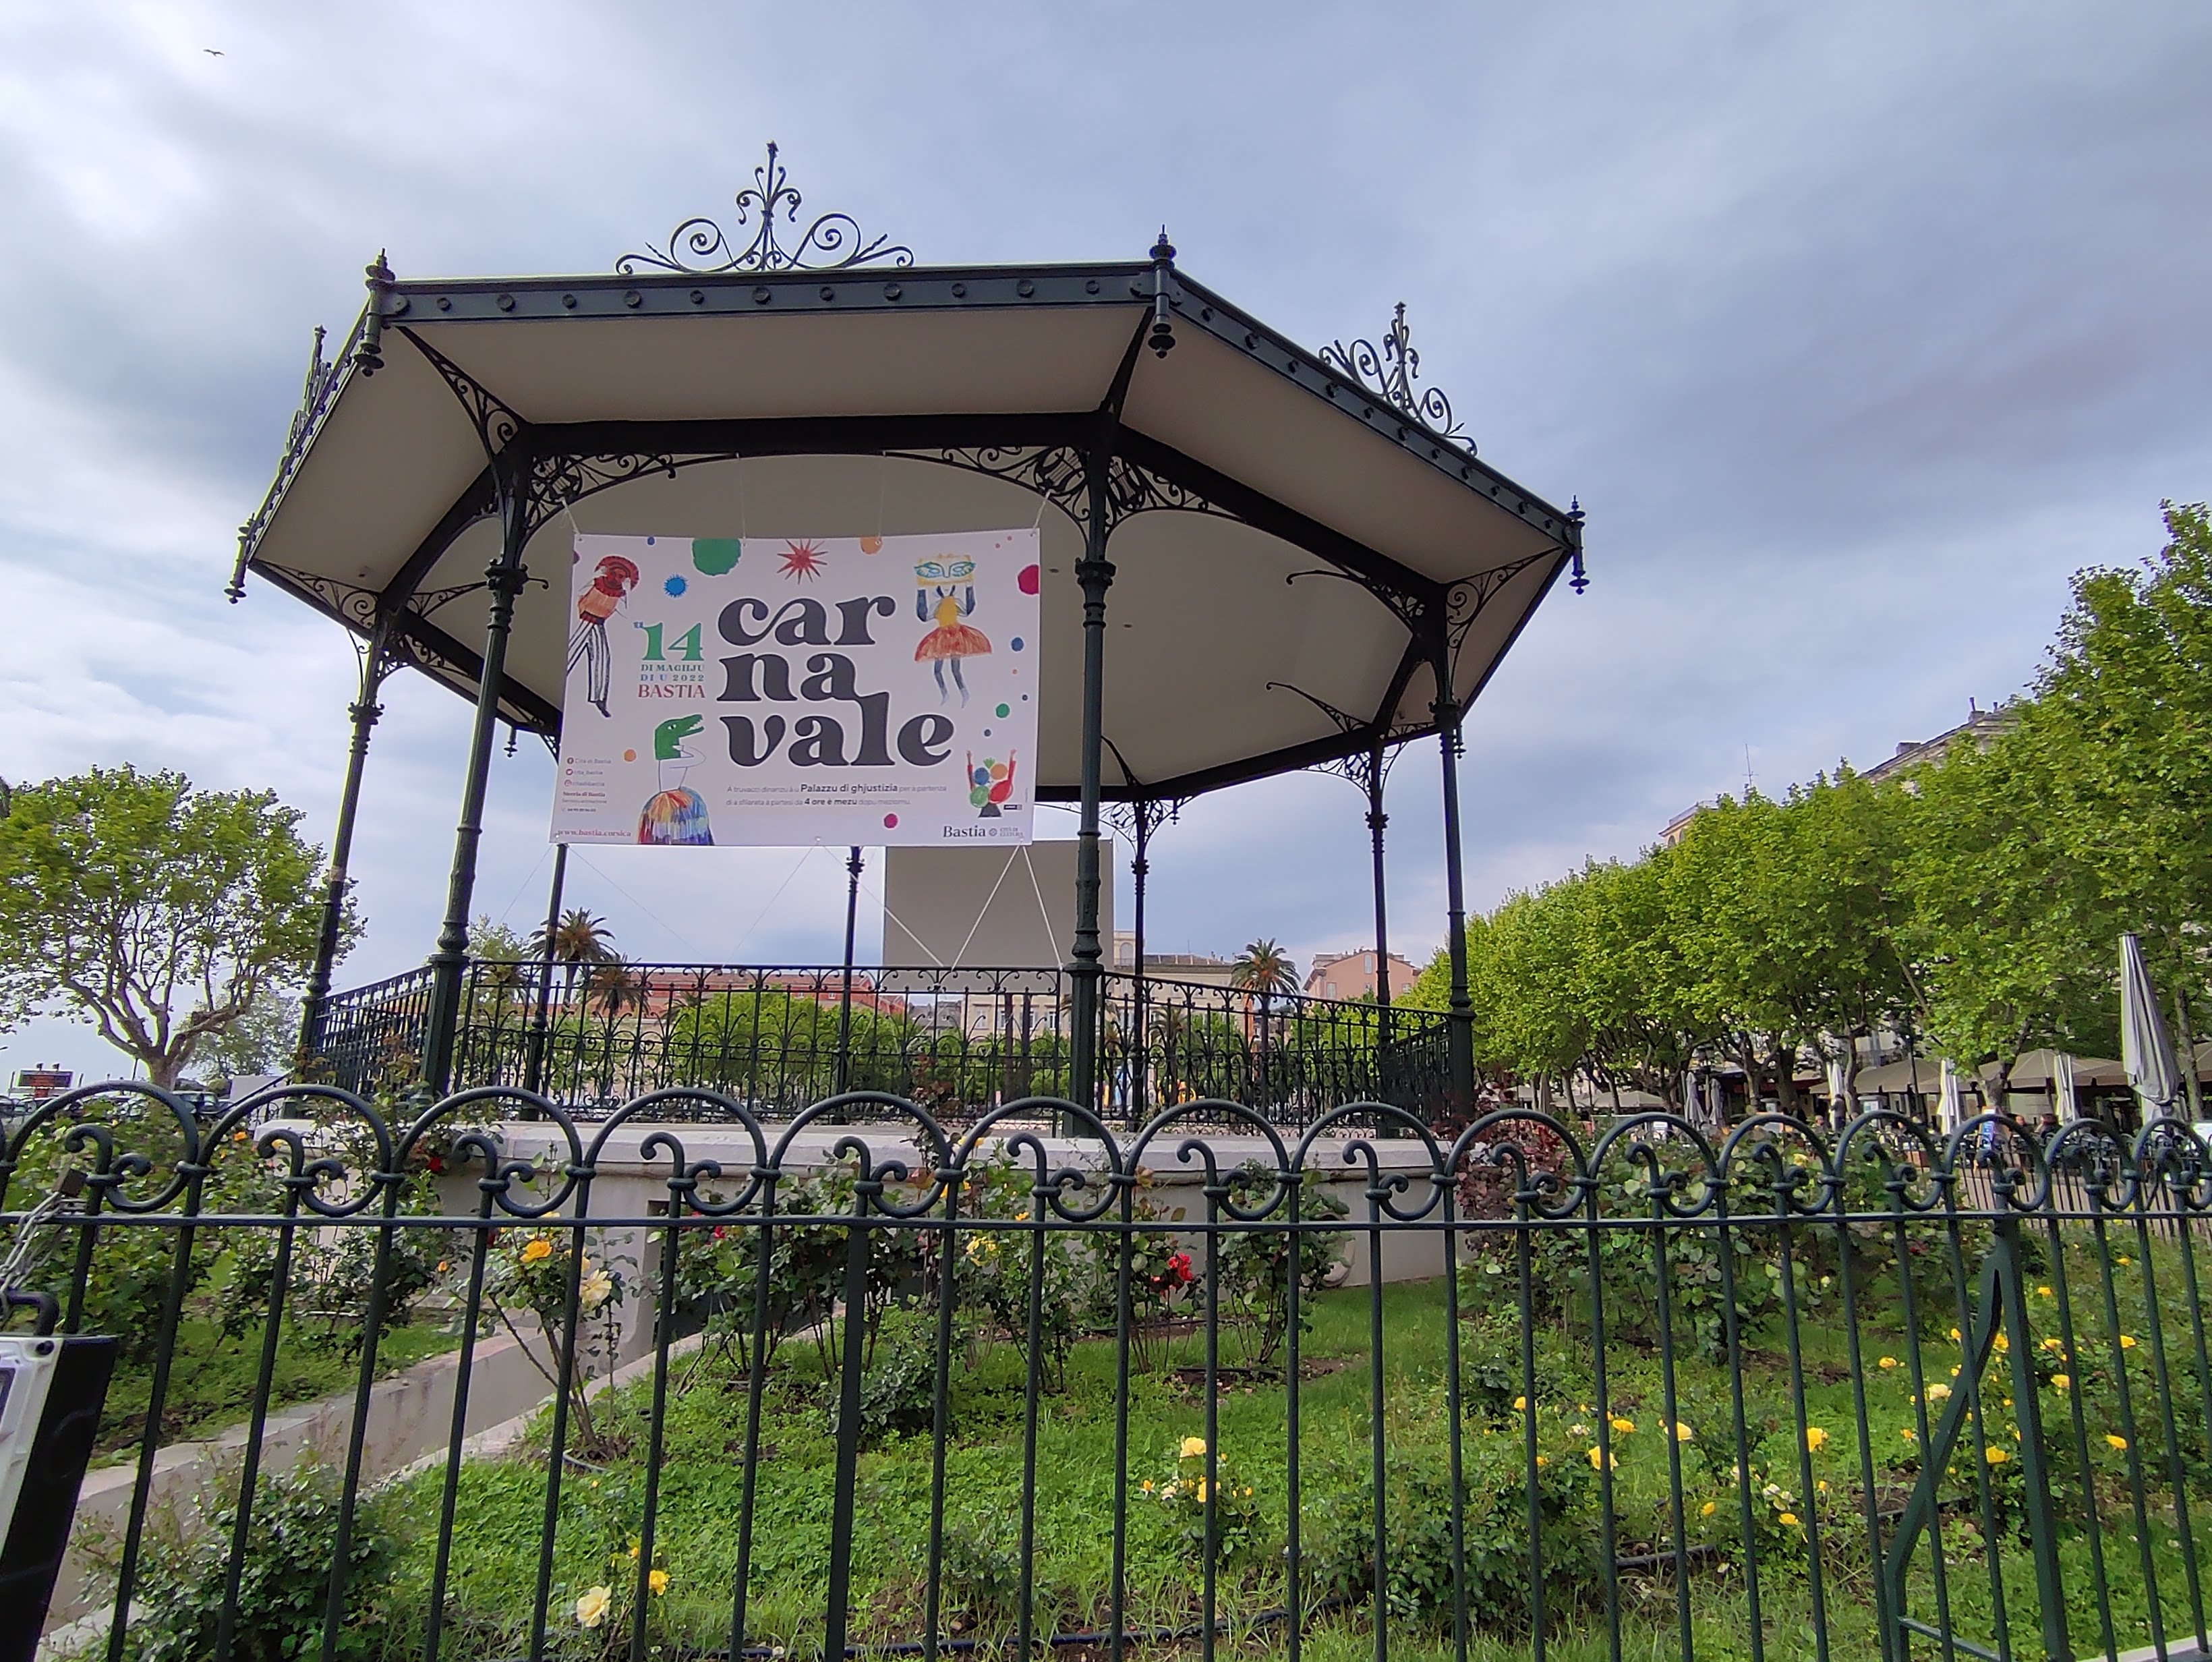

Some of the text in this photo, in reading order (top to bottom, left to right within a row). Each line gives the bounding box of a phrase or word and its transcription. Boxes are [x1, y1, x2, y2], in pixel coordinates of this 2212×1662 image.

[641, 622, 704, 661] 14
[638, 684, 706, 699] BASTIA
[801, 784, 838, 793] Palazzu
[840, 784, 849, 792] di
[851, 784, 898, 794] ghjustizia
[556, 829, 632, 837] www.bastia.corsica
[943, 825, 986, 837] Bastia
